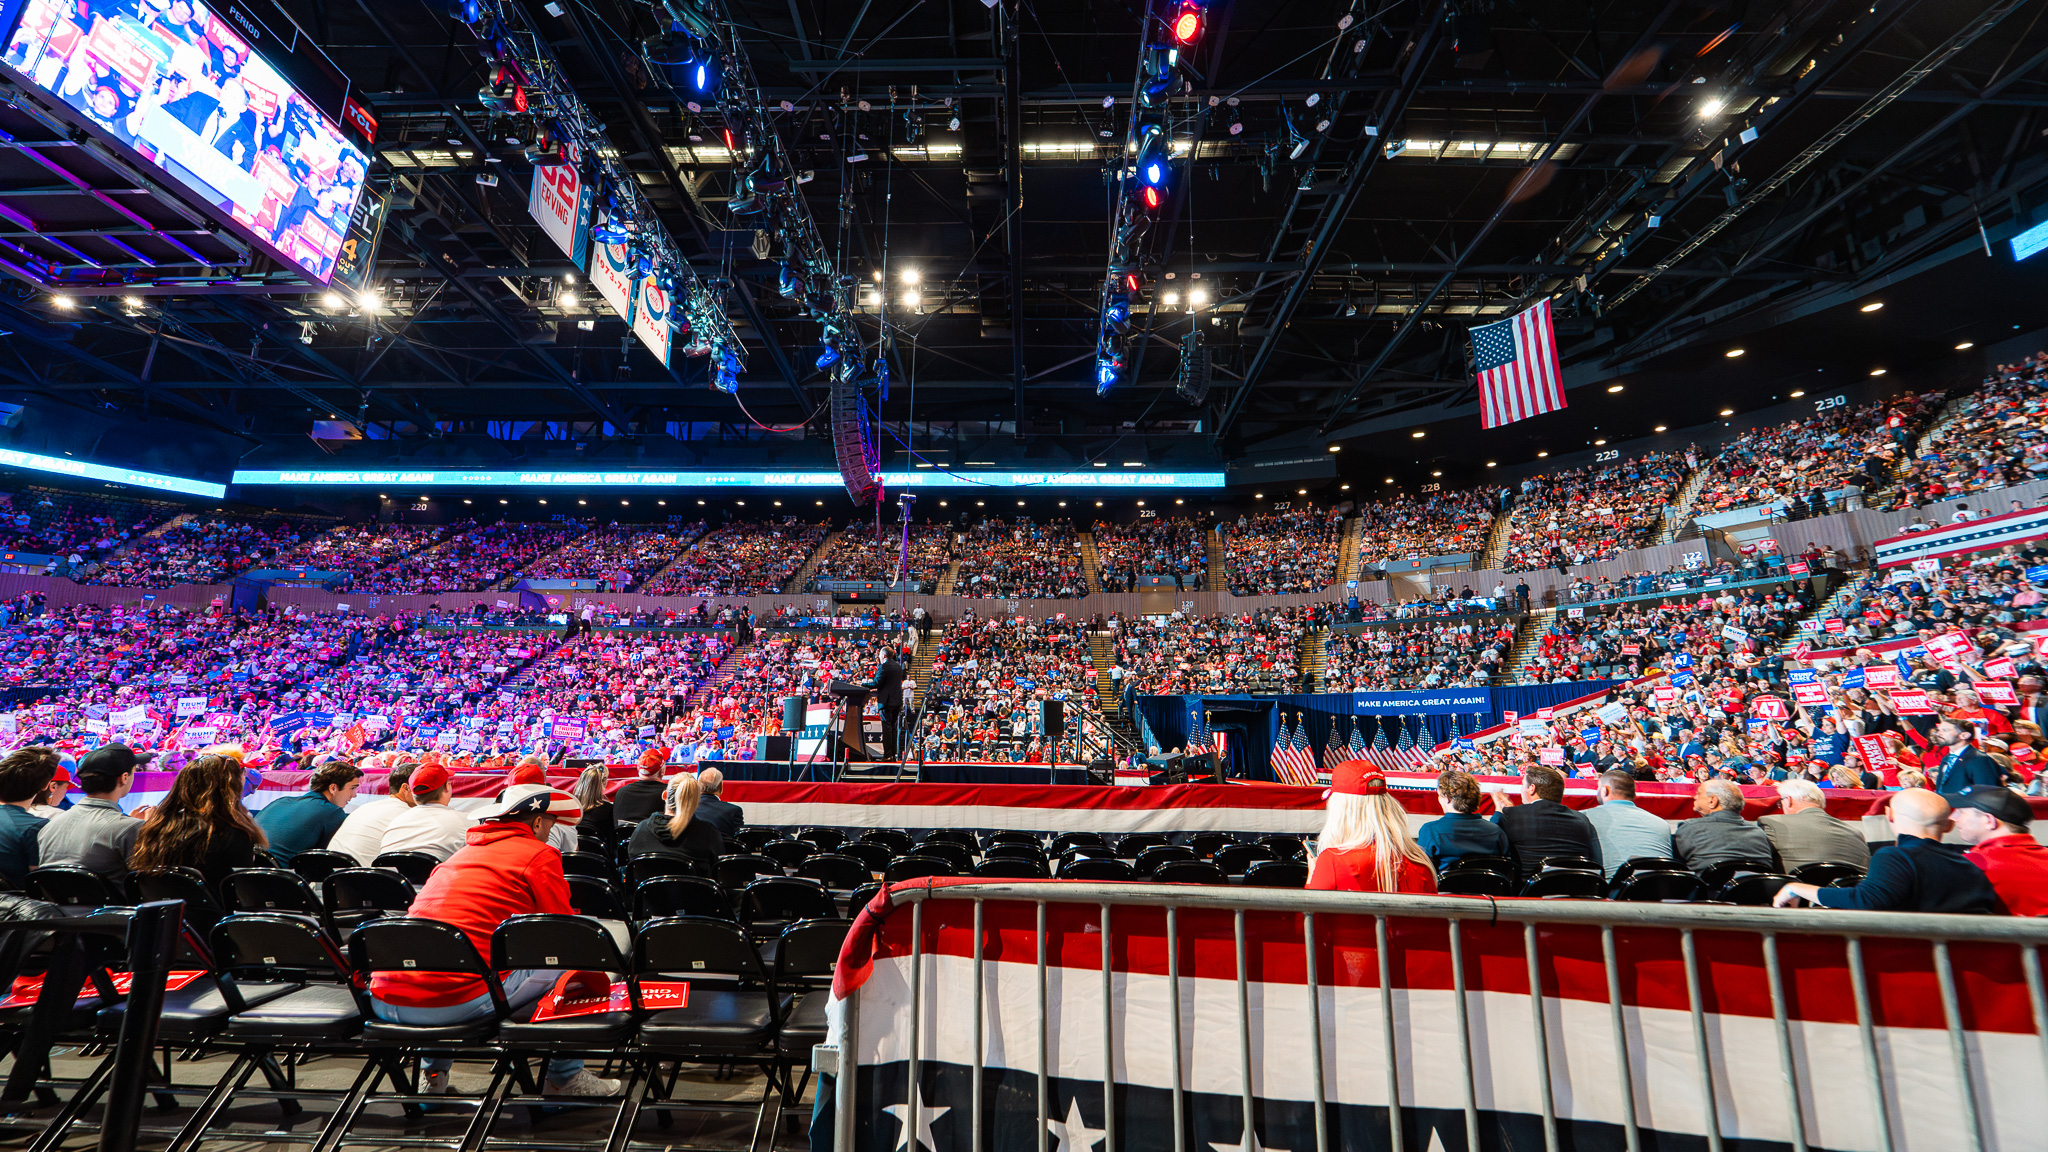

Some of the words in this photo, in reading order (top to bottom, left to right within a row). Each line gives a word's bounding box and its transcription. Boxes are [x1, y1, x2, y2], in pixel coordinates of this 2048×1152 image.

[229, 5, 260, 39] PERIOD
[348, 104, 373, 134] TCL
[541, 181, 569, 225] ERVING
[597, 253, 627, 296] 1973-74
[640, 307, 665, 342] 1975-76
[1814, 394, 1847, 412] 230
[1595, 449, 1620, 463] 229
[28, 456, 86, 474] AGAIN
[280, 473, 311, 482] MAKE
[312, 473, 360, 482] AMERICA
[362, 473, 401, 482] GREAT
[399, 473, 434, 482] AGAIN
[520, 473, 552, 483] MAKE
[553, 473, 602, 483] AMERICA
[604, 473, 640, 483] GREAT
[641, 474, 677, 483] AGAIN
[764, 474, 796, 484] MAKE
[887, 475, 923, 484] AGAIN
[1013, 475, 1045, 484] MAKE
[1046, 475, 1098, 484] AMERICA
[1099, 475, 1136, 484] GREAT
[1138, 475, 1175, 484] AGAIN
[1421, 483, 1440, 493] 228
[411, 503, 428, 511] 220
[1274, 501, 1291, 510] 227
[1140, 509, 1156, 518] 226
[1760, 540, 1775, 548] 47
[1682, 552, 1703, 560] 122
[1686, 561, 1700, 570] 22
[1917, 561, 1935, 570] 47
[1725, 627, 1746, 637] TRUMP
[1381, 643, 1391, 651] 47
[1675, 655, 1688, 665] 47
[1796, 684, 1822, 693] DRAIN
[1053, 692, 1065, 700] 47
[1893, 695, 1927, 704] TRUMP
[1358, 699, 1381, 707] MAKE
[1422, 698, 1451, 706] GREAT
[1453, 696, 1485, 705] AGAIN!
[38, 705, 51, 713] 47
[1759, 701, 1780, 716] 47
[213, 718, 232, 727] 47
[404, 717, 419, 725] 47
[460, 716, 470, 725] 47
[1748, 720, 1768, 728] TRUMP
[462, 737, 479, 745] TRUMP
[582, 748, 595, 756] 47
[1860, 737, 1881, 770] TRUMP
[1871, 737, 1887, 766] VANCE
